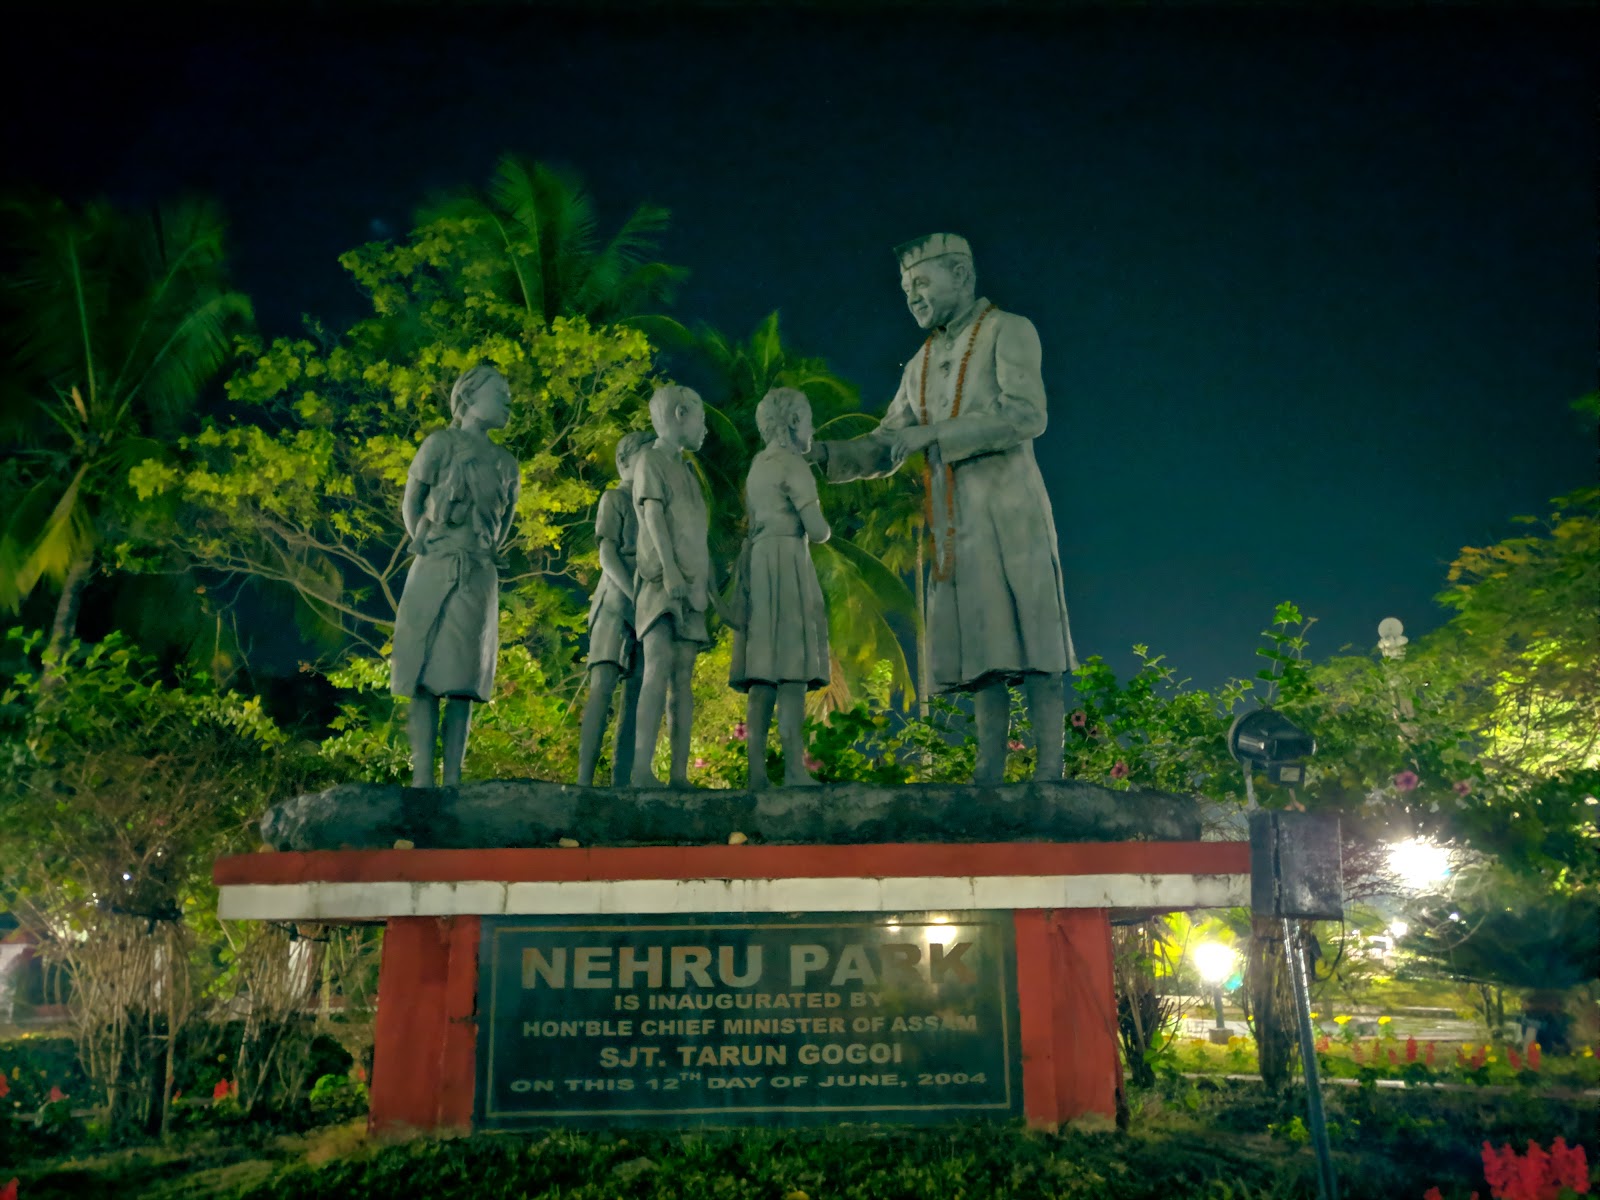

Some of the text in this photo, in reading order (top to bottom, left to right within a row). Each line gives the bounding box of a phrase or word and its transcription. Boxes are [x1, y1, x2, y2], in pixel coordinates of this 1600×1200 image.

[521, 942, 977, 989] NEHRU PARK
[614, 991, 883, 1011] IS INAUGURATED BY
[523, 1014, 977, 1037] HON'BLE CHIEF MINISTER OF ASSAM
[600, 1043, 903, 1068] SJT. TARUN GOGOI
[510, 1079, 554, 1092] ON
[565, 1078, 635, 1091] THIS
[708, 1077, 762, 1089] DAY
[770, 1075, 808, 1087] OF
[818, 1073, 908, 1088] JUNE,
[918, 1072, 987, 1086] 2004
